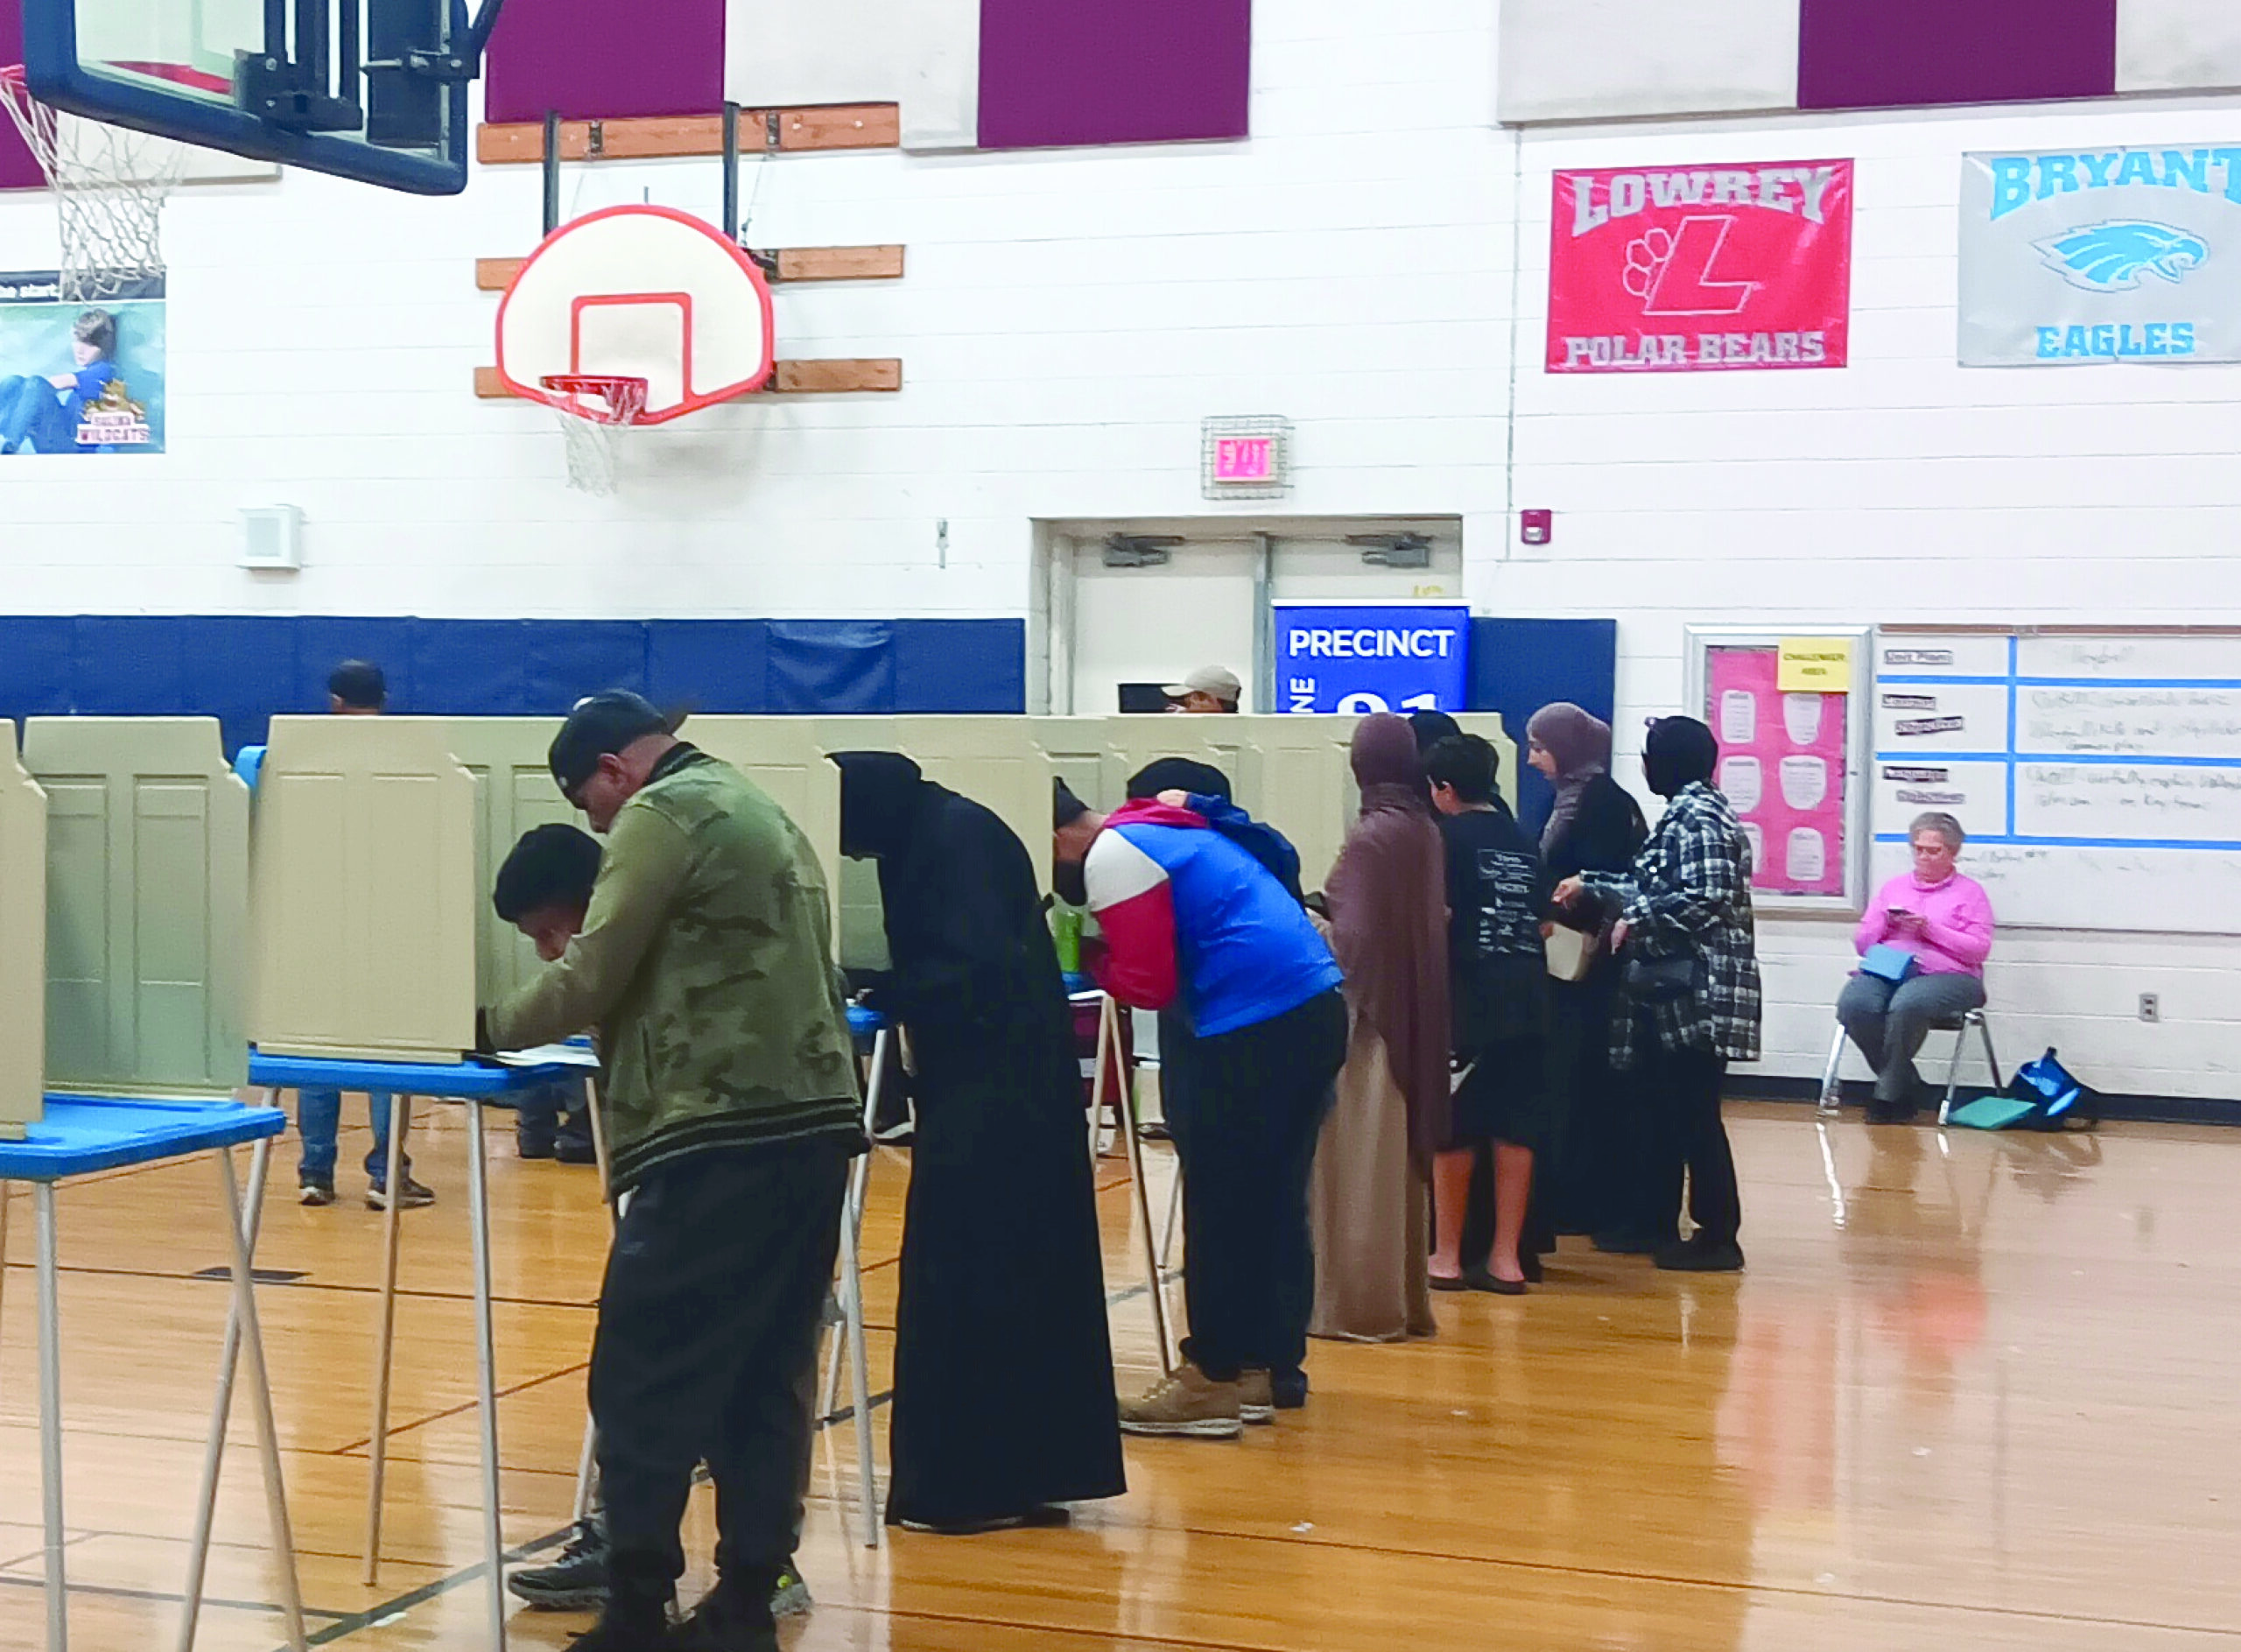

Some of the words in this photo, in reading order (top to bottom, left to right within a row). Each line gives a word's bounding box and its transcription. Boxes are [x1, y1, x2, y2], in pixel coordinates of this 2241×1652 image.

[1571, 167, 1836, 237] LOWREY
[1990, 148, 2241, 221] BRYANT
[1564, 334, 1688, 367] POLAR
[1697, 330, 1826, 363] BEARS
[2035, 321, 2195, 358] EAGLES
[1218, 439, 1269, 477] EXIT
[1289, 629, 1456, 657] PRECINCT
